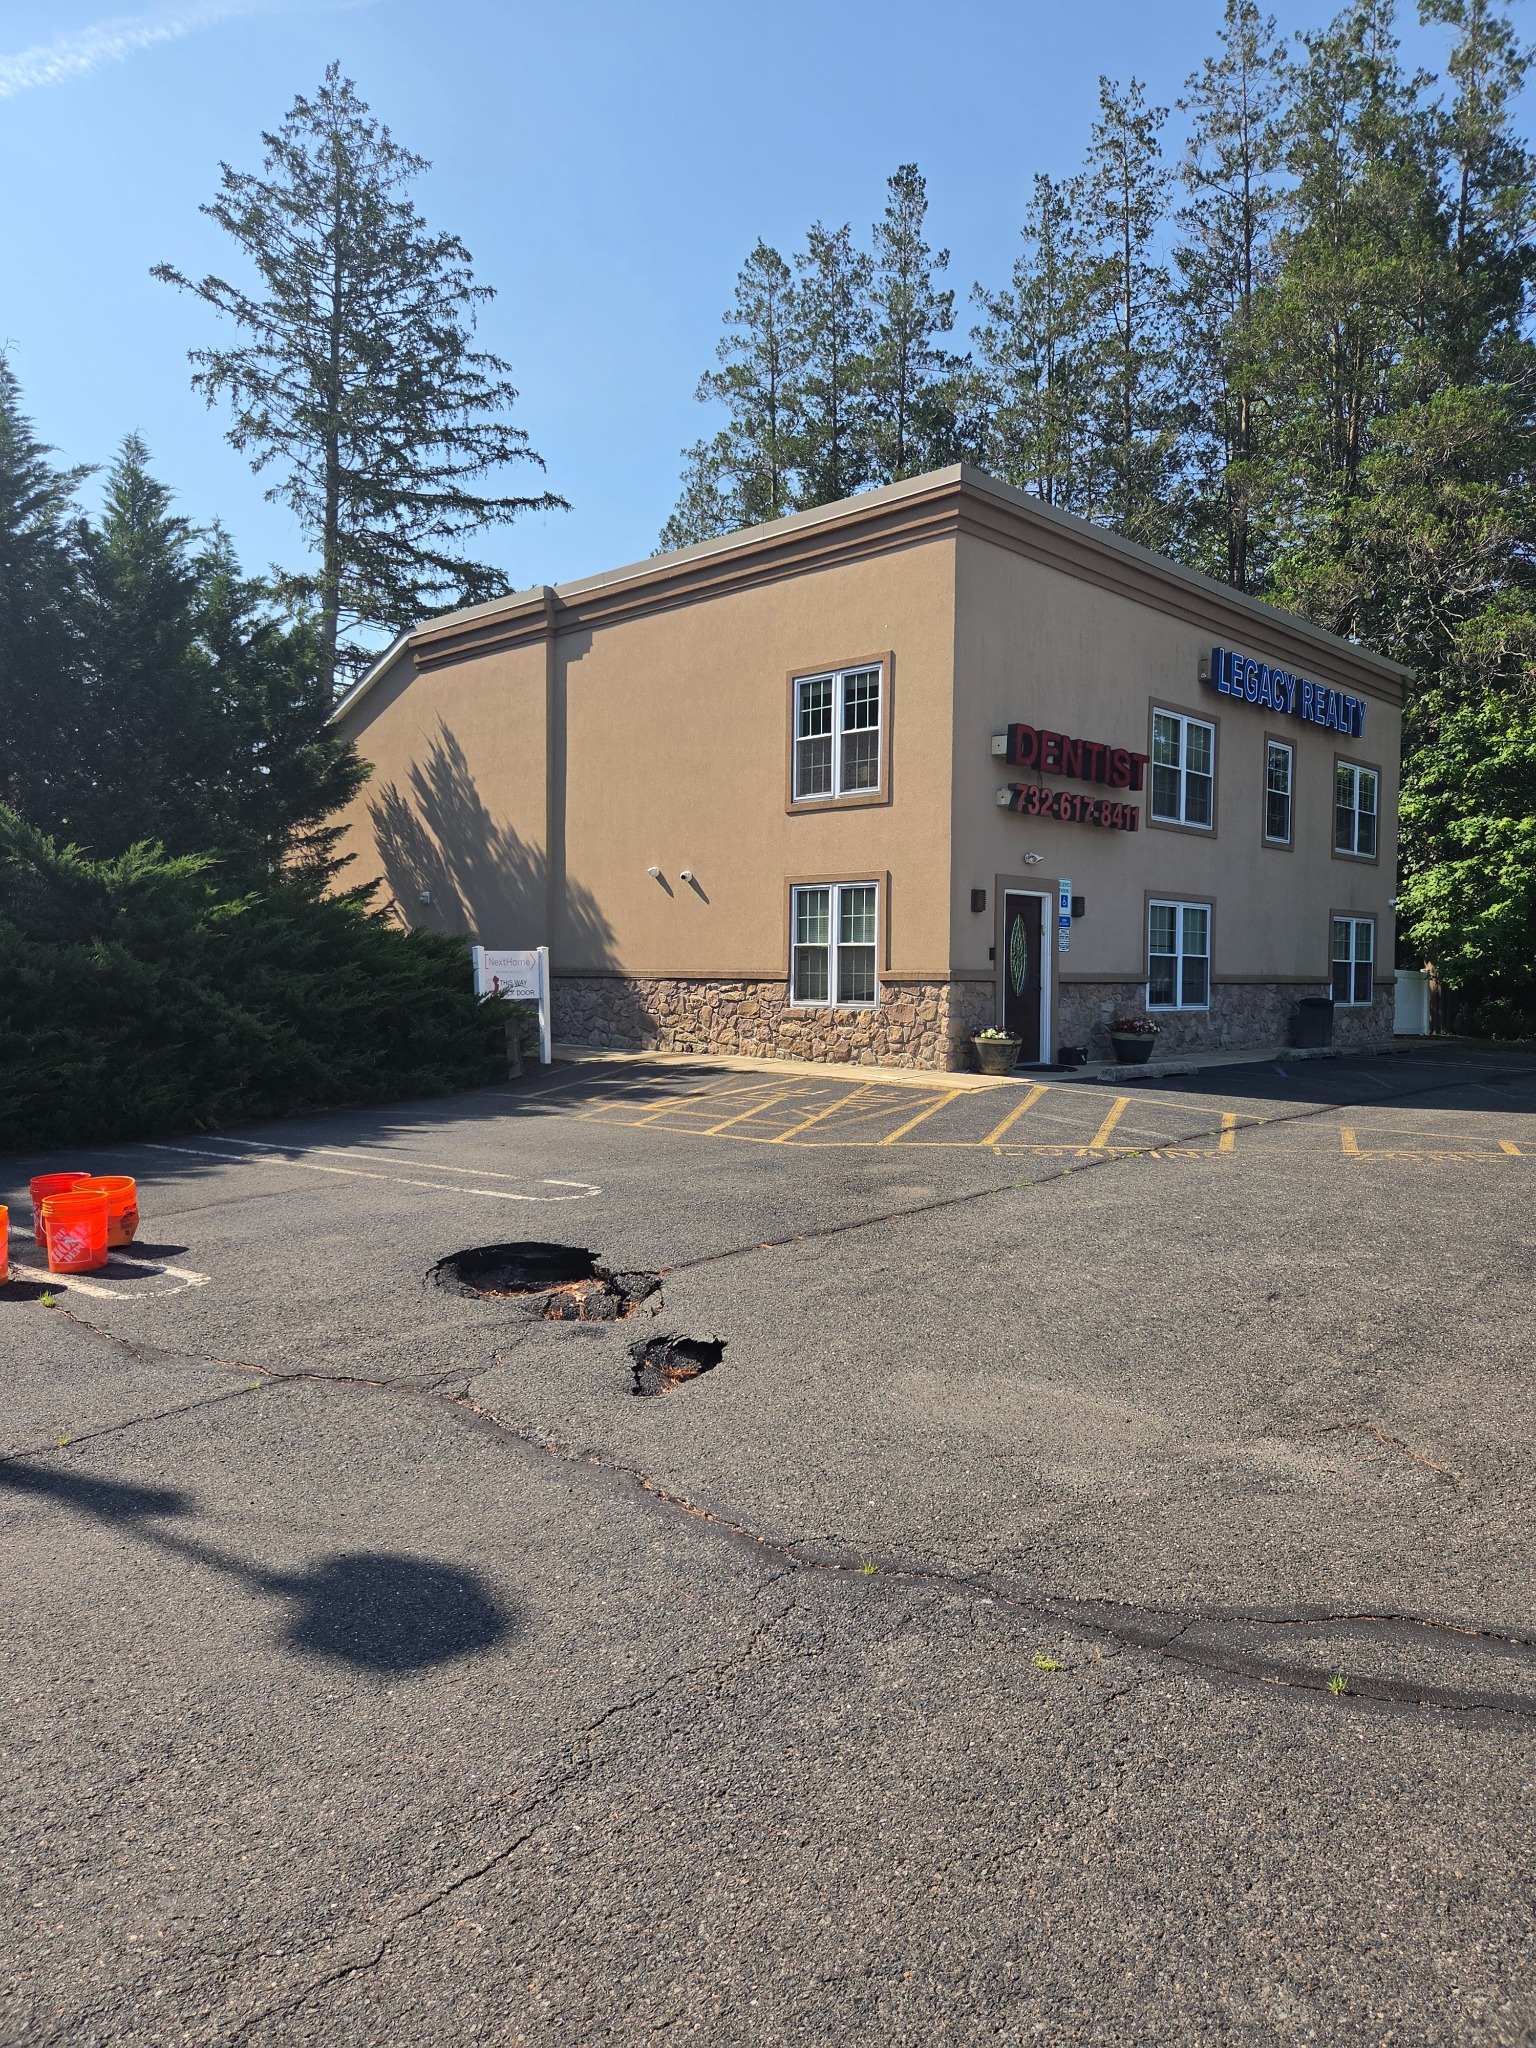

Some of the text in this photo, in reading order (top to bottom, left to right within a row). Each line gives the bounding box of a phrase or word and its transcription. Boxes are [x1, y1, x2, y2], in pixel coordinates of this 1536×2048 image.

[1213, 647, 1368, 738] LEGACY REALTY
[1008, 723, 1150, 791] DENTIST
[1009, 783, 1139, 832] 732-617-8411
[488, 957, 531, 967] NextHome
